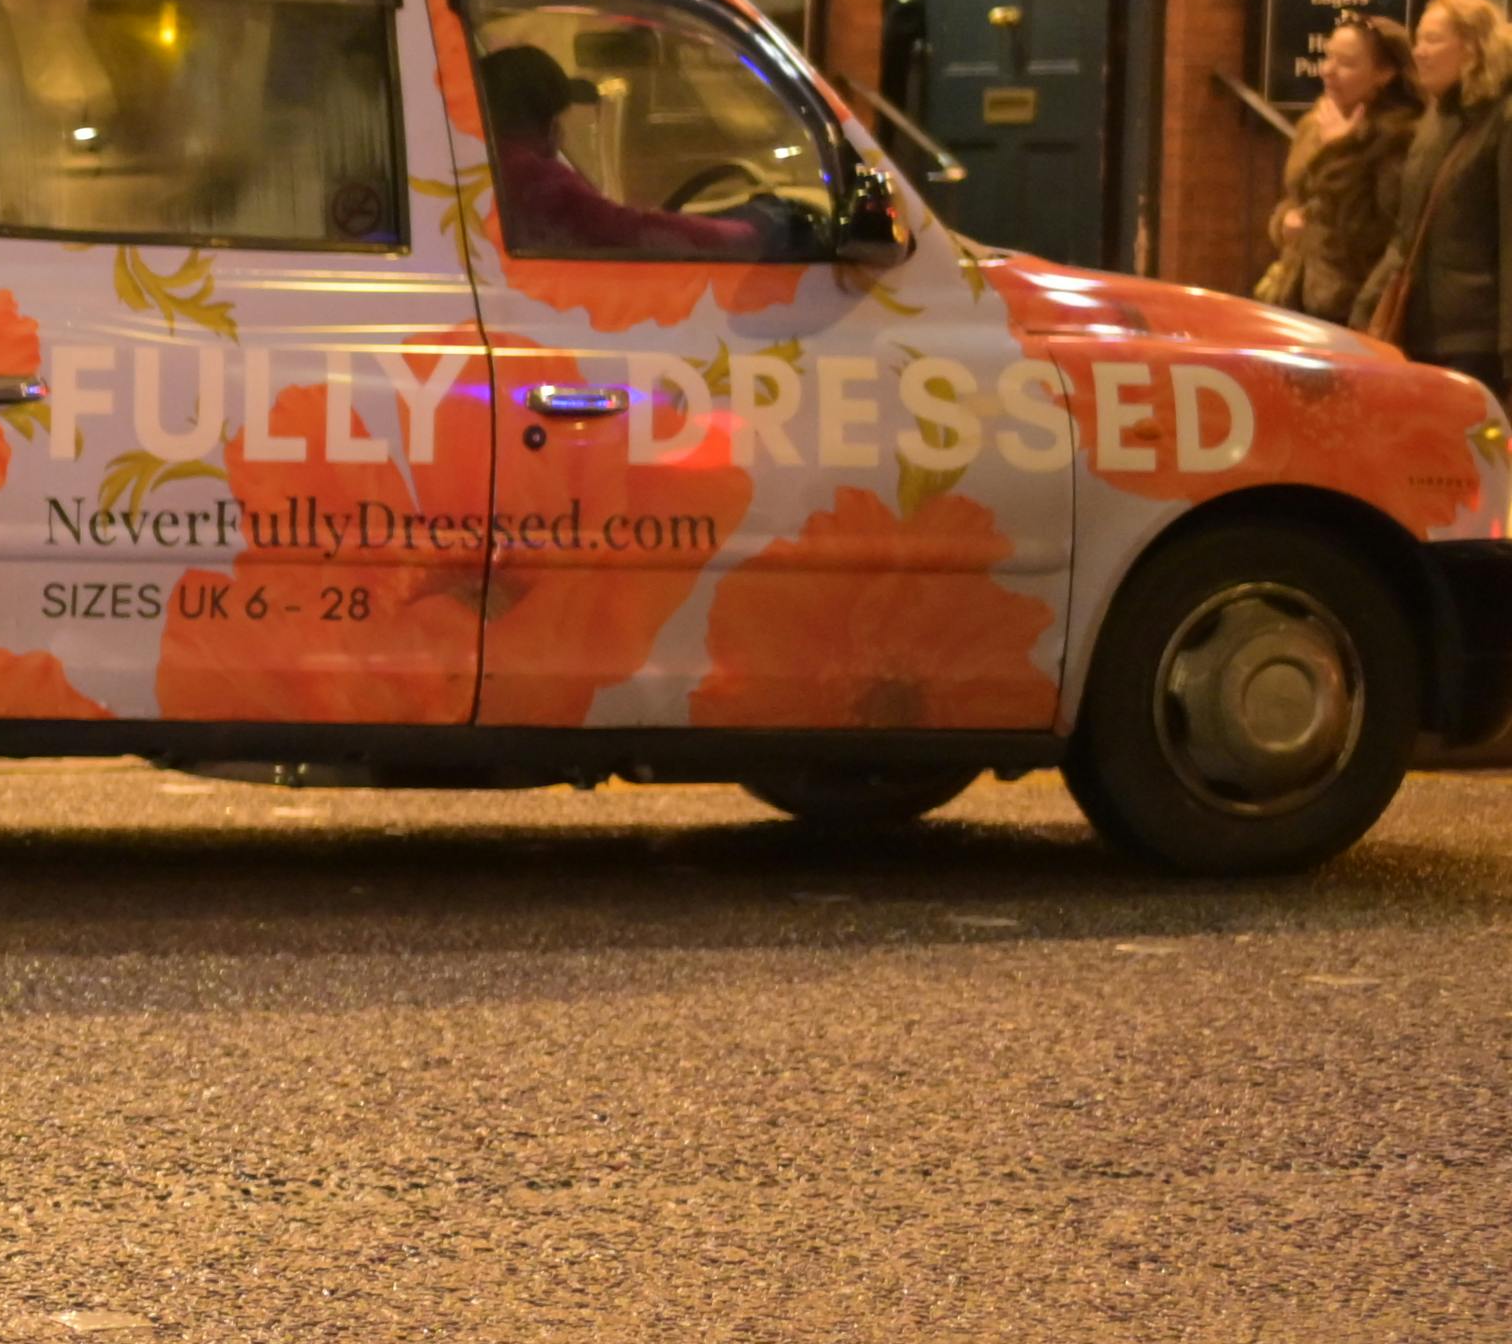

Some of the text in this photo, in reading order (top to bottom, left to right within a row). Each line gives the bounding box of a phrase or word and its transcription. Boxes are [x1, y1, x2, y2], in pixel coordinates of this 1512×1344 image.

[49, 345, 476, 464] FULLY
[626, 354, 1255, 473] DRESSED
[43, 496, 718, 560] NeverFullyDressed.com
[41, 582, 162, 620] SIZES
[178, 585, 230, 620] UK
[244, 585, 266, 621] 6
[320, 587, 372, 621] 28
